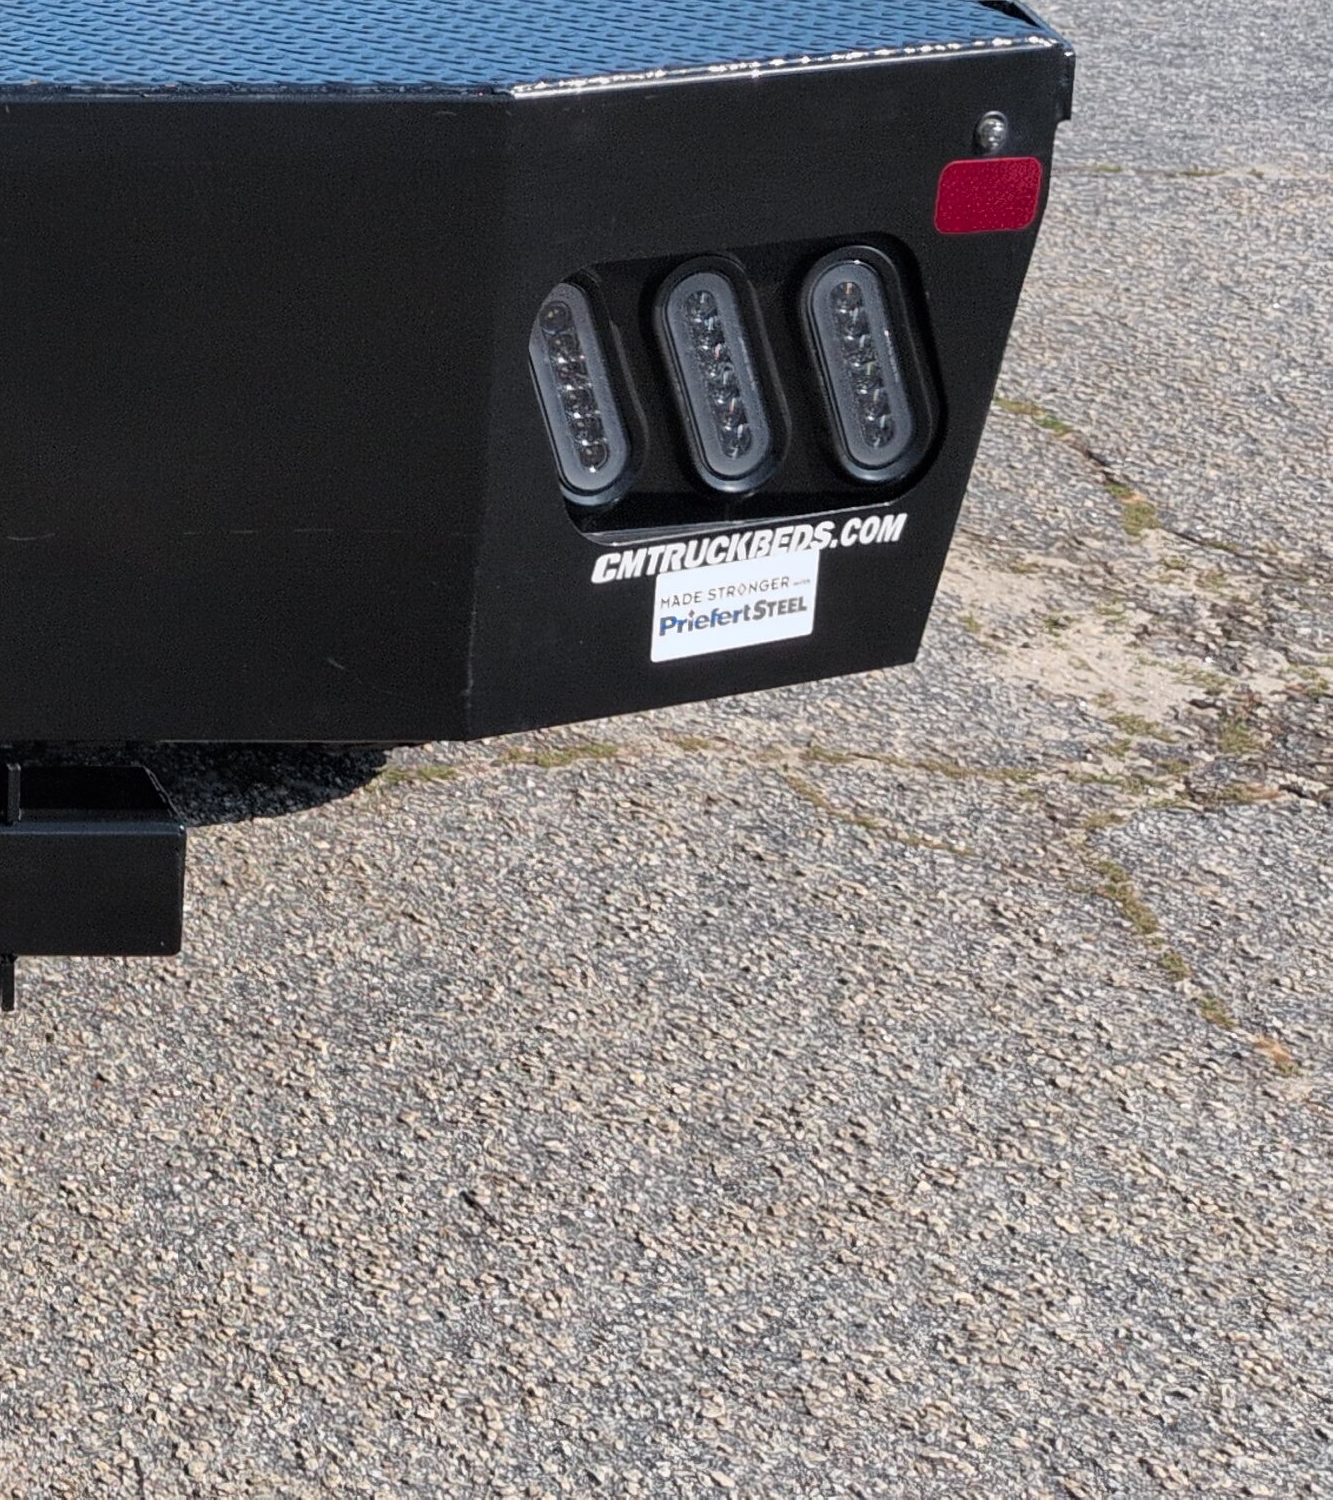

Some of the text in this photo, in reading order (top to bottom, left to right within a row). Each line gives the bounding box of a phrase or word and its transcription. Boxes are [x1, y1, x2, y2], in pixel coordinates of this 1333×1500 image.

[590, 512, 908, 585] CMTRUCKBEDS.COM
[660, 576, 790, 609] MADE STRONGER
